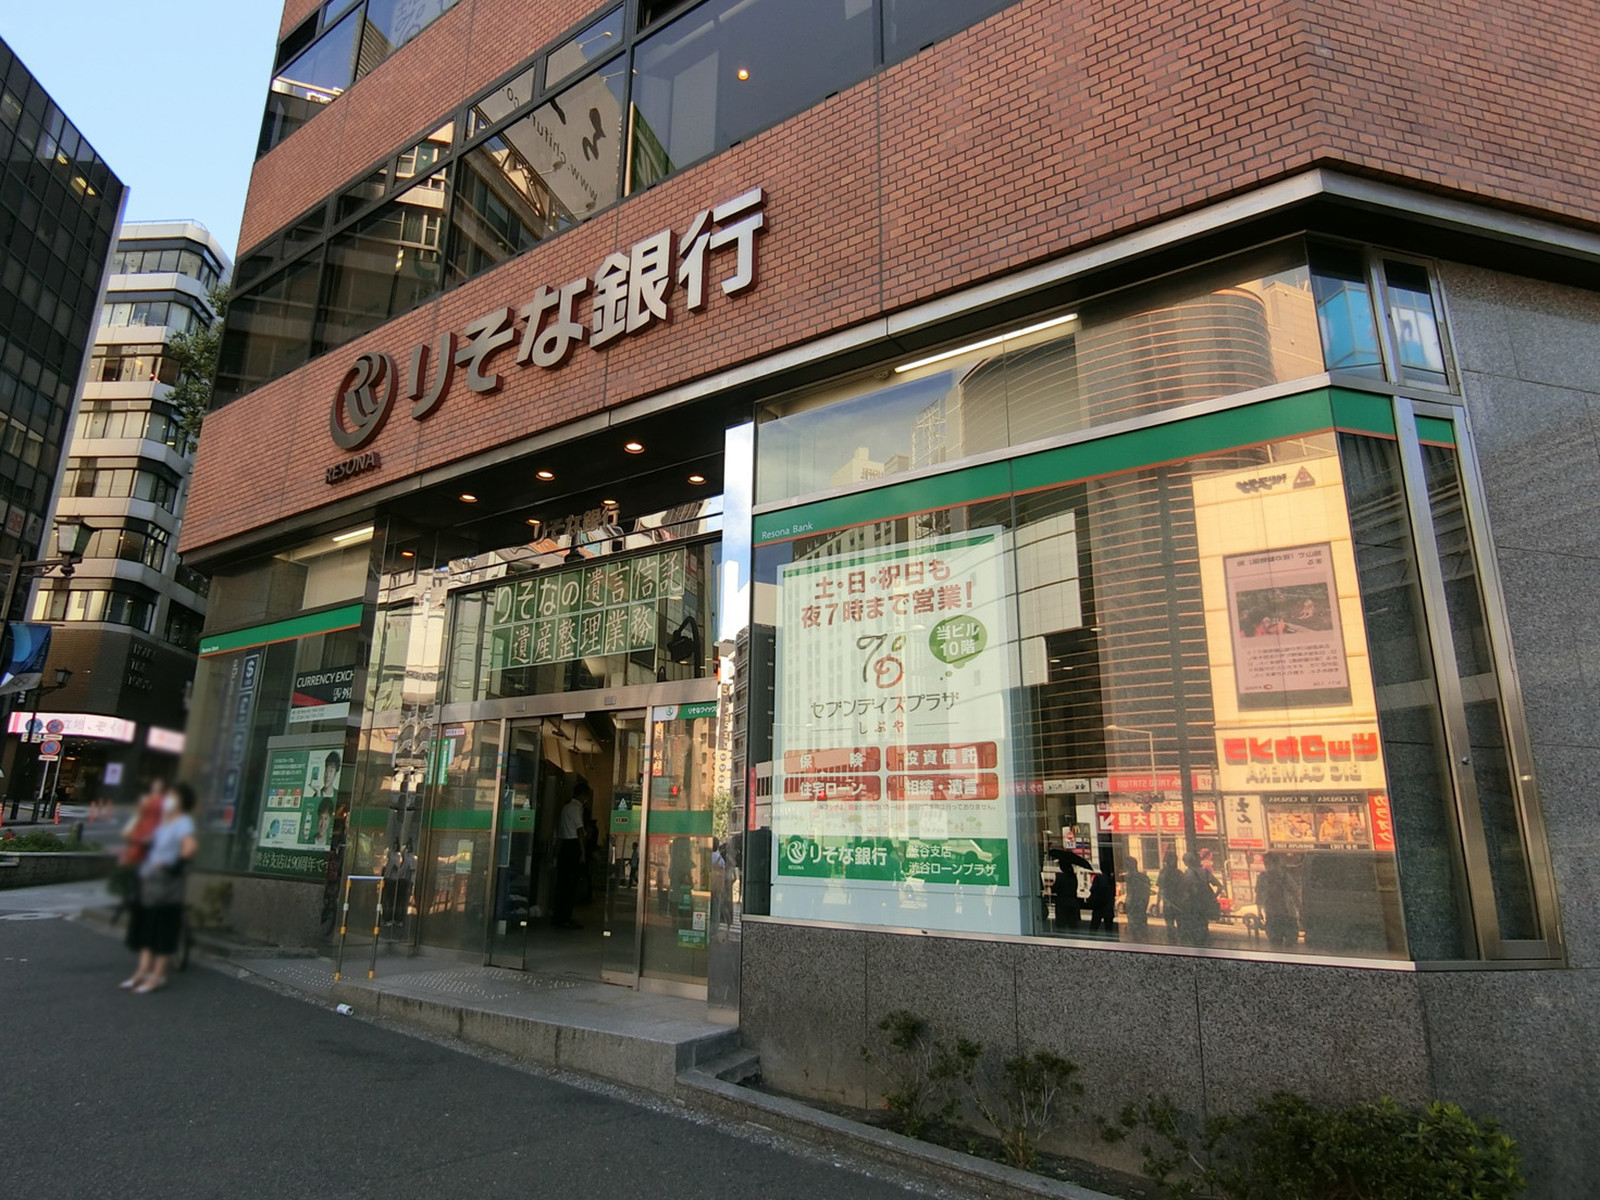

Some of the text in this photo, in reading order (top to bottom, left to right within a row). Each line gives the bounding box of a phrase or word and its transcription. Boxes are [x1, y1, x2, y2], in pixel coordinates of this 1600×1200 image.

[407, 187, 769, 421] りそな銀行
[325, 452, 380, 484] RESONA
[762, 521, 814, 540] Resona Bank
[814, 558, 951, 599] 土・日・祝日も
[496, 553, 682, 624] りそなの遺言信託
[801, 581, 973, 629] 夜7時まで営業!
[512, 604, 654, 664] 遺産整理業務
[936, 623, 980, 640] 当ビル
[940, 639, 976, 657] 10階
[296, 673, 336, 688] CURRENCY
[859, 721, 905, 735] しぶや
[905, 747, 977, 766] 投資信託
[800, 781, 866, 797] 住宅ローン
[905, 778, 979, 796] 相続・遺言
[809, 847, 888, 867] りそな銀行
[906, 844, 952, 858] 渋谷支店
[908, 861, 998, 877] 渋谷ローンプラザ
